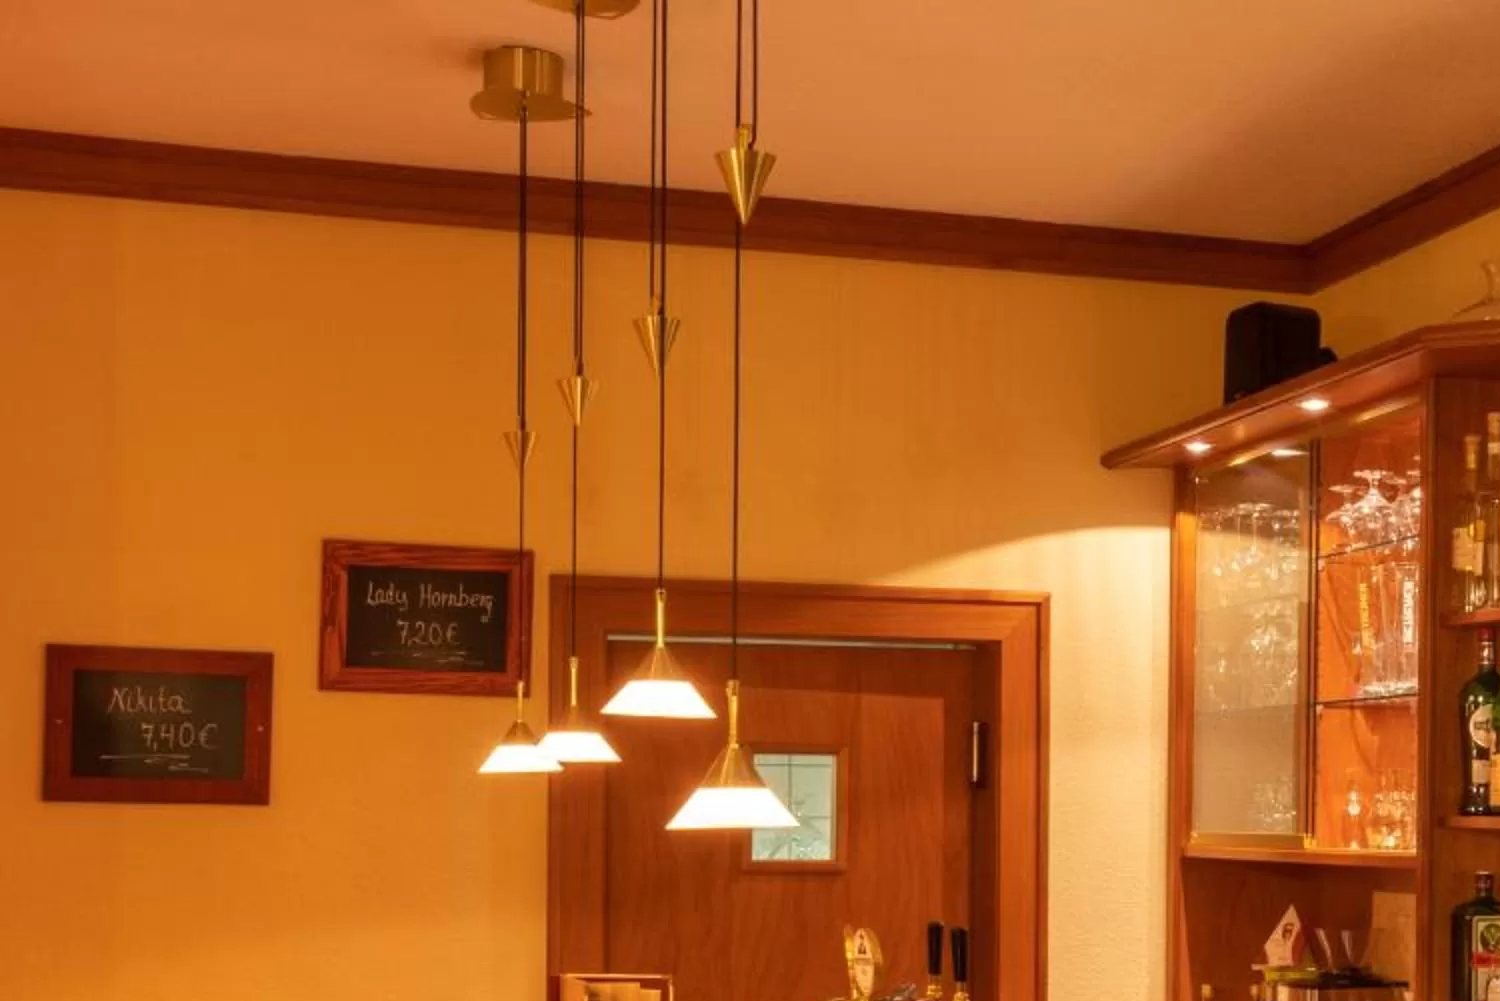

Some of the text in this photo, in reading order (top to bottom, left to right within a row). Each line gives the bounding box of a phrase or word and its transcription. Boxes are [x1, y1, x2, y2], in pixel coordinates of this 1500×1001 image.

[367, 580, 494, 624] Lady Hornberg
[396, 618, 461, 648] 7,20€
[106, 685, 193, 715] Nikita
[141, 721, 219, 751] 7,40€
